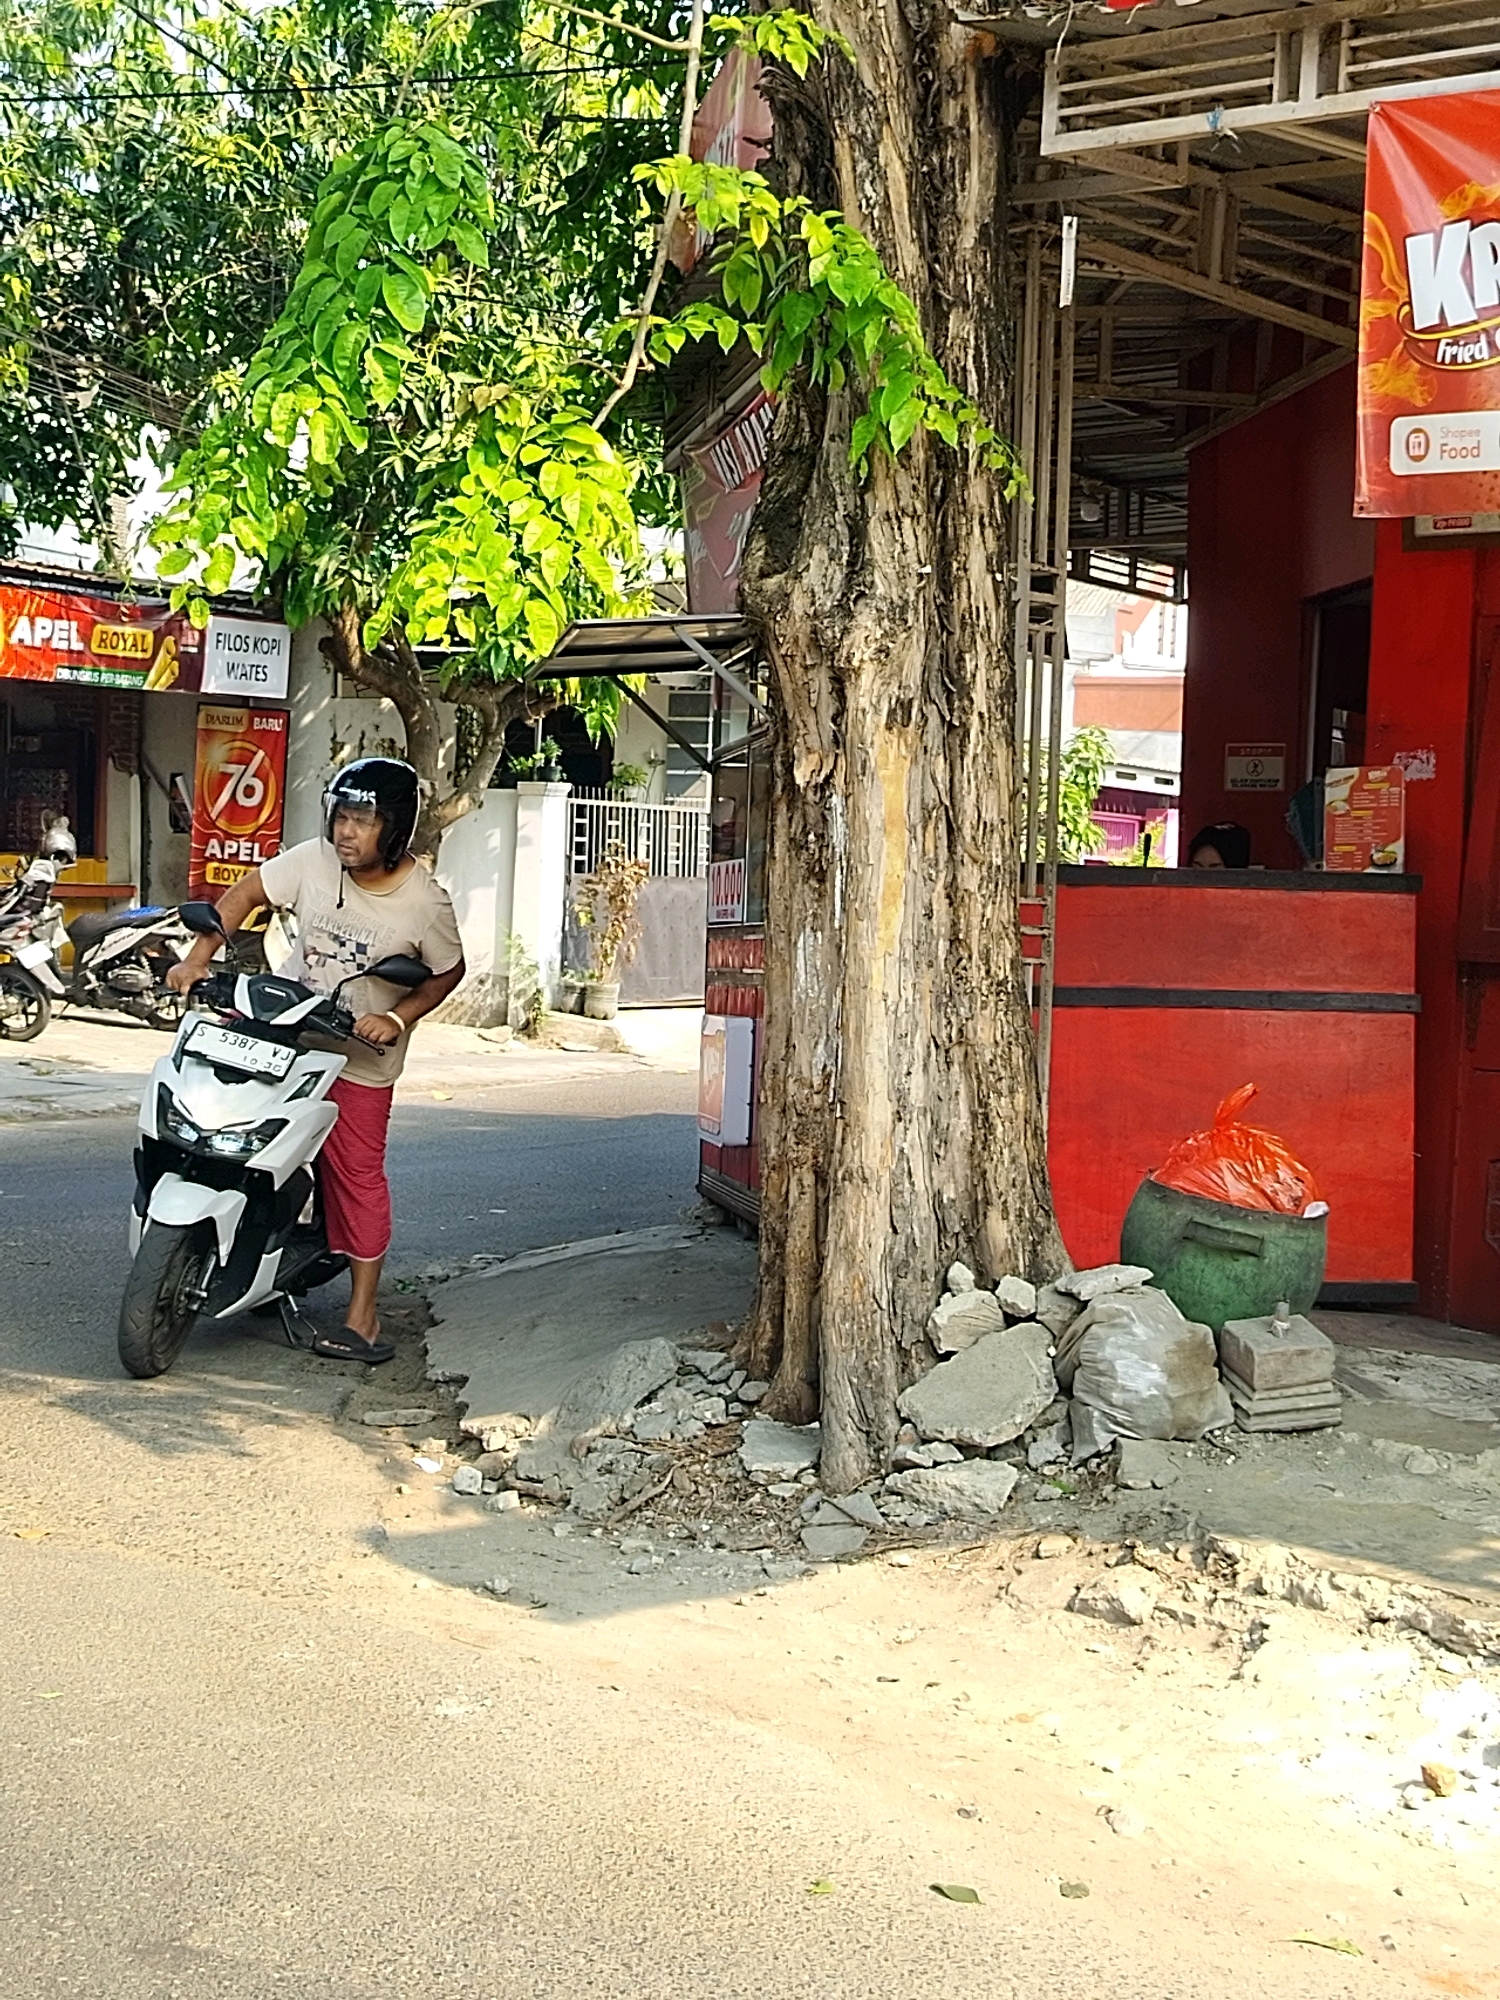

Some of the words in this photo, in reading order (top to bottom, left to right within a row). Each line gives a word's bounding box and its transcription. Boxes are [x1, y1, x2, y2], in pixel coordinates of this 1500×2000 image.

[1440, 426, 1481, 441] Shopee
[1439, 440, 1481, 461] Food
[9, 615, 84, 651] APEL
[96, 630, 149, 653] ROYAL
[215, 632, 250, 653] FILOS
[252, 636, 282, 656] KOPI
[226, 661, 269, 682] WATES
[253, 717, 284, 731] BARU
[209, 749, 266, 821] 76
[204, 838, 268, 862] APEL
[711, 861, 743, 906] 10.000
[311, 911, 376, 948] BARCELONA
[197, 1026, 208, 1037] S
[218, 1031, 259, 1051] 5387
